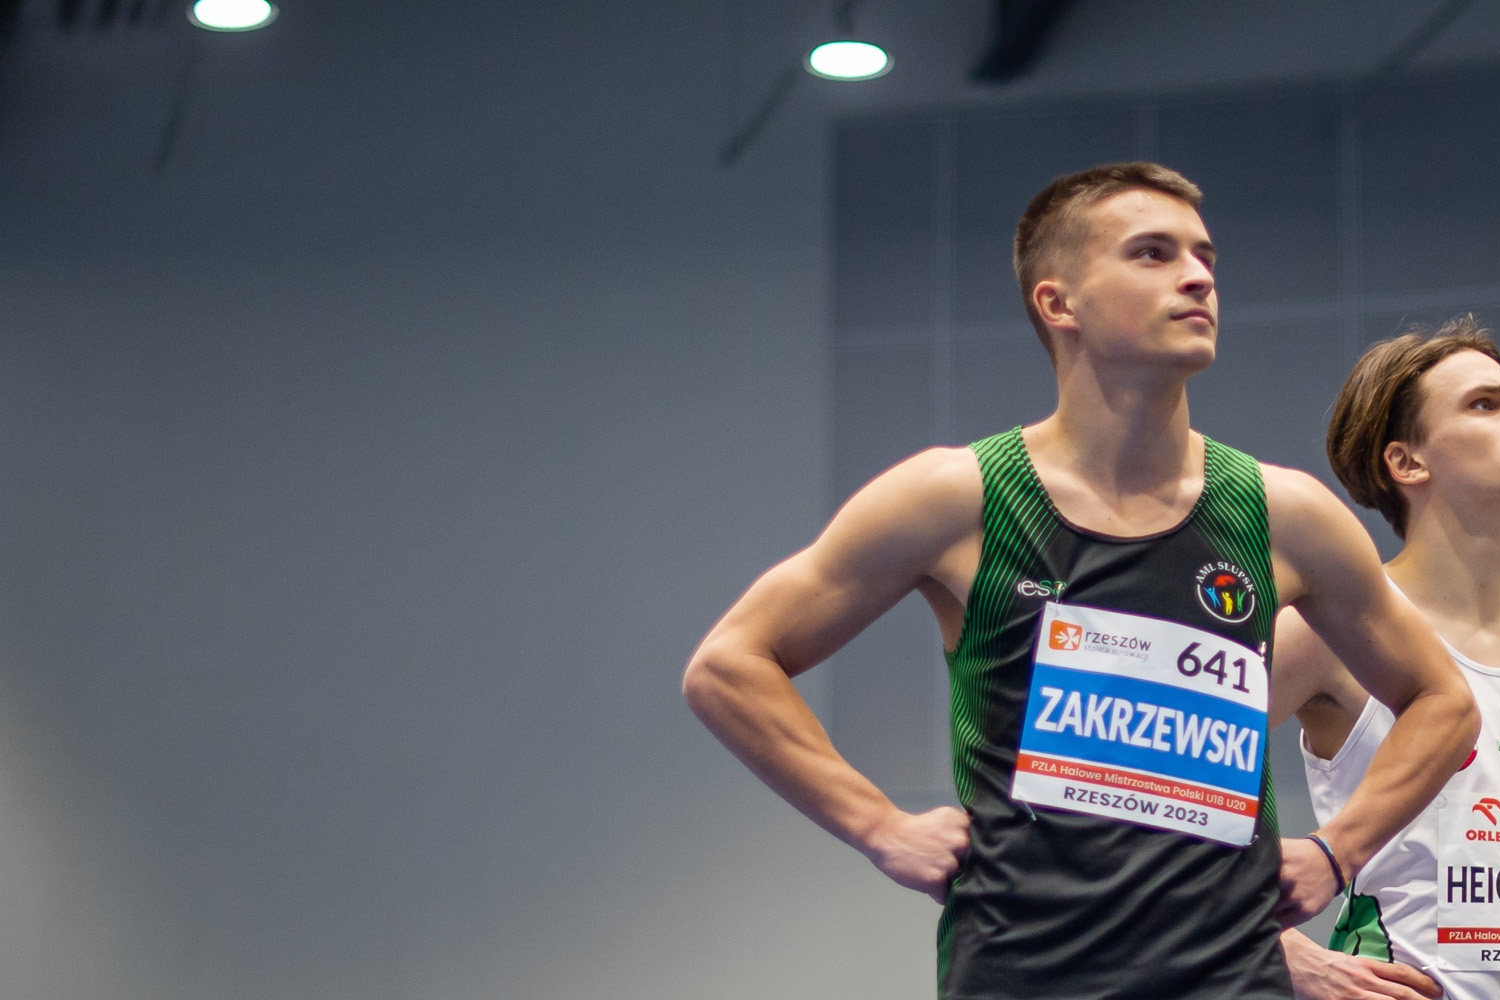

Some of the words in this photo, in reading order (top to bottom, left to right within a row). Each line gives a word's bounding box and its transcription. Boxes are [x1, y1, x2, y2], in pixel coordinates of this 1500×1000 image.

[1196, 563, 1216, 583] AML
[1085, 631, 1152, 651] rzeszów
[1177, 642, 1250, 694] 641
[1034, 686, 1259, 773] ZAKRZEWSKI
[1031, 760, 1058, 774] PZLA
[1060, 764, 1102, 781] Halowe
[1104, 773, 1171, 794] Mistrzostwa
[1173, 786, 1204, 802] Polski
[1206, 792, 1225, 806] U18
[1226, 797, 1247, 812] U20
[1063, 785, 1159, 816] RZESZÓW
[1163, 804, 1209, 827] 2023
[1449, 931, 1472, 941] PZLA
